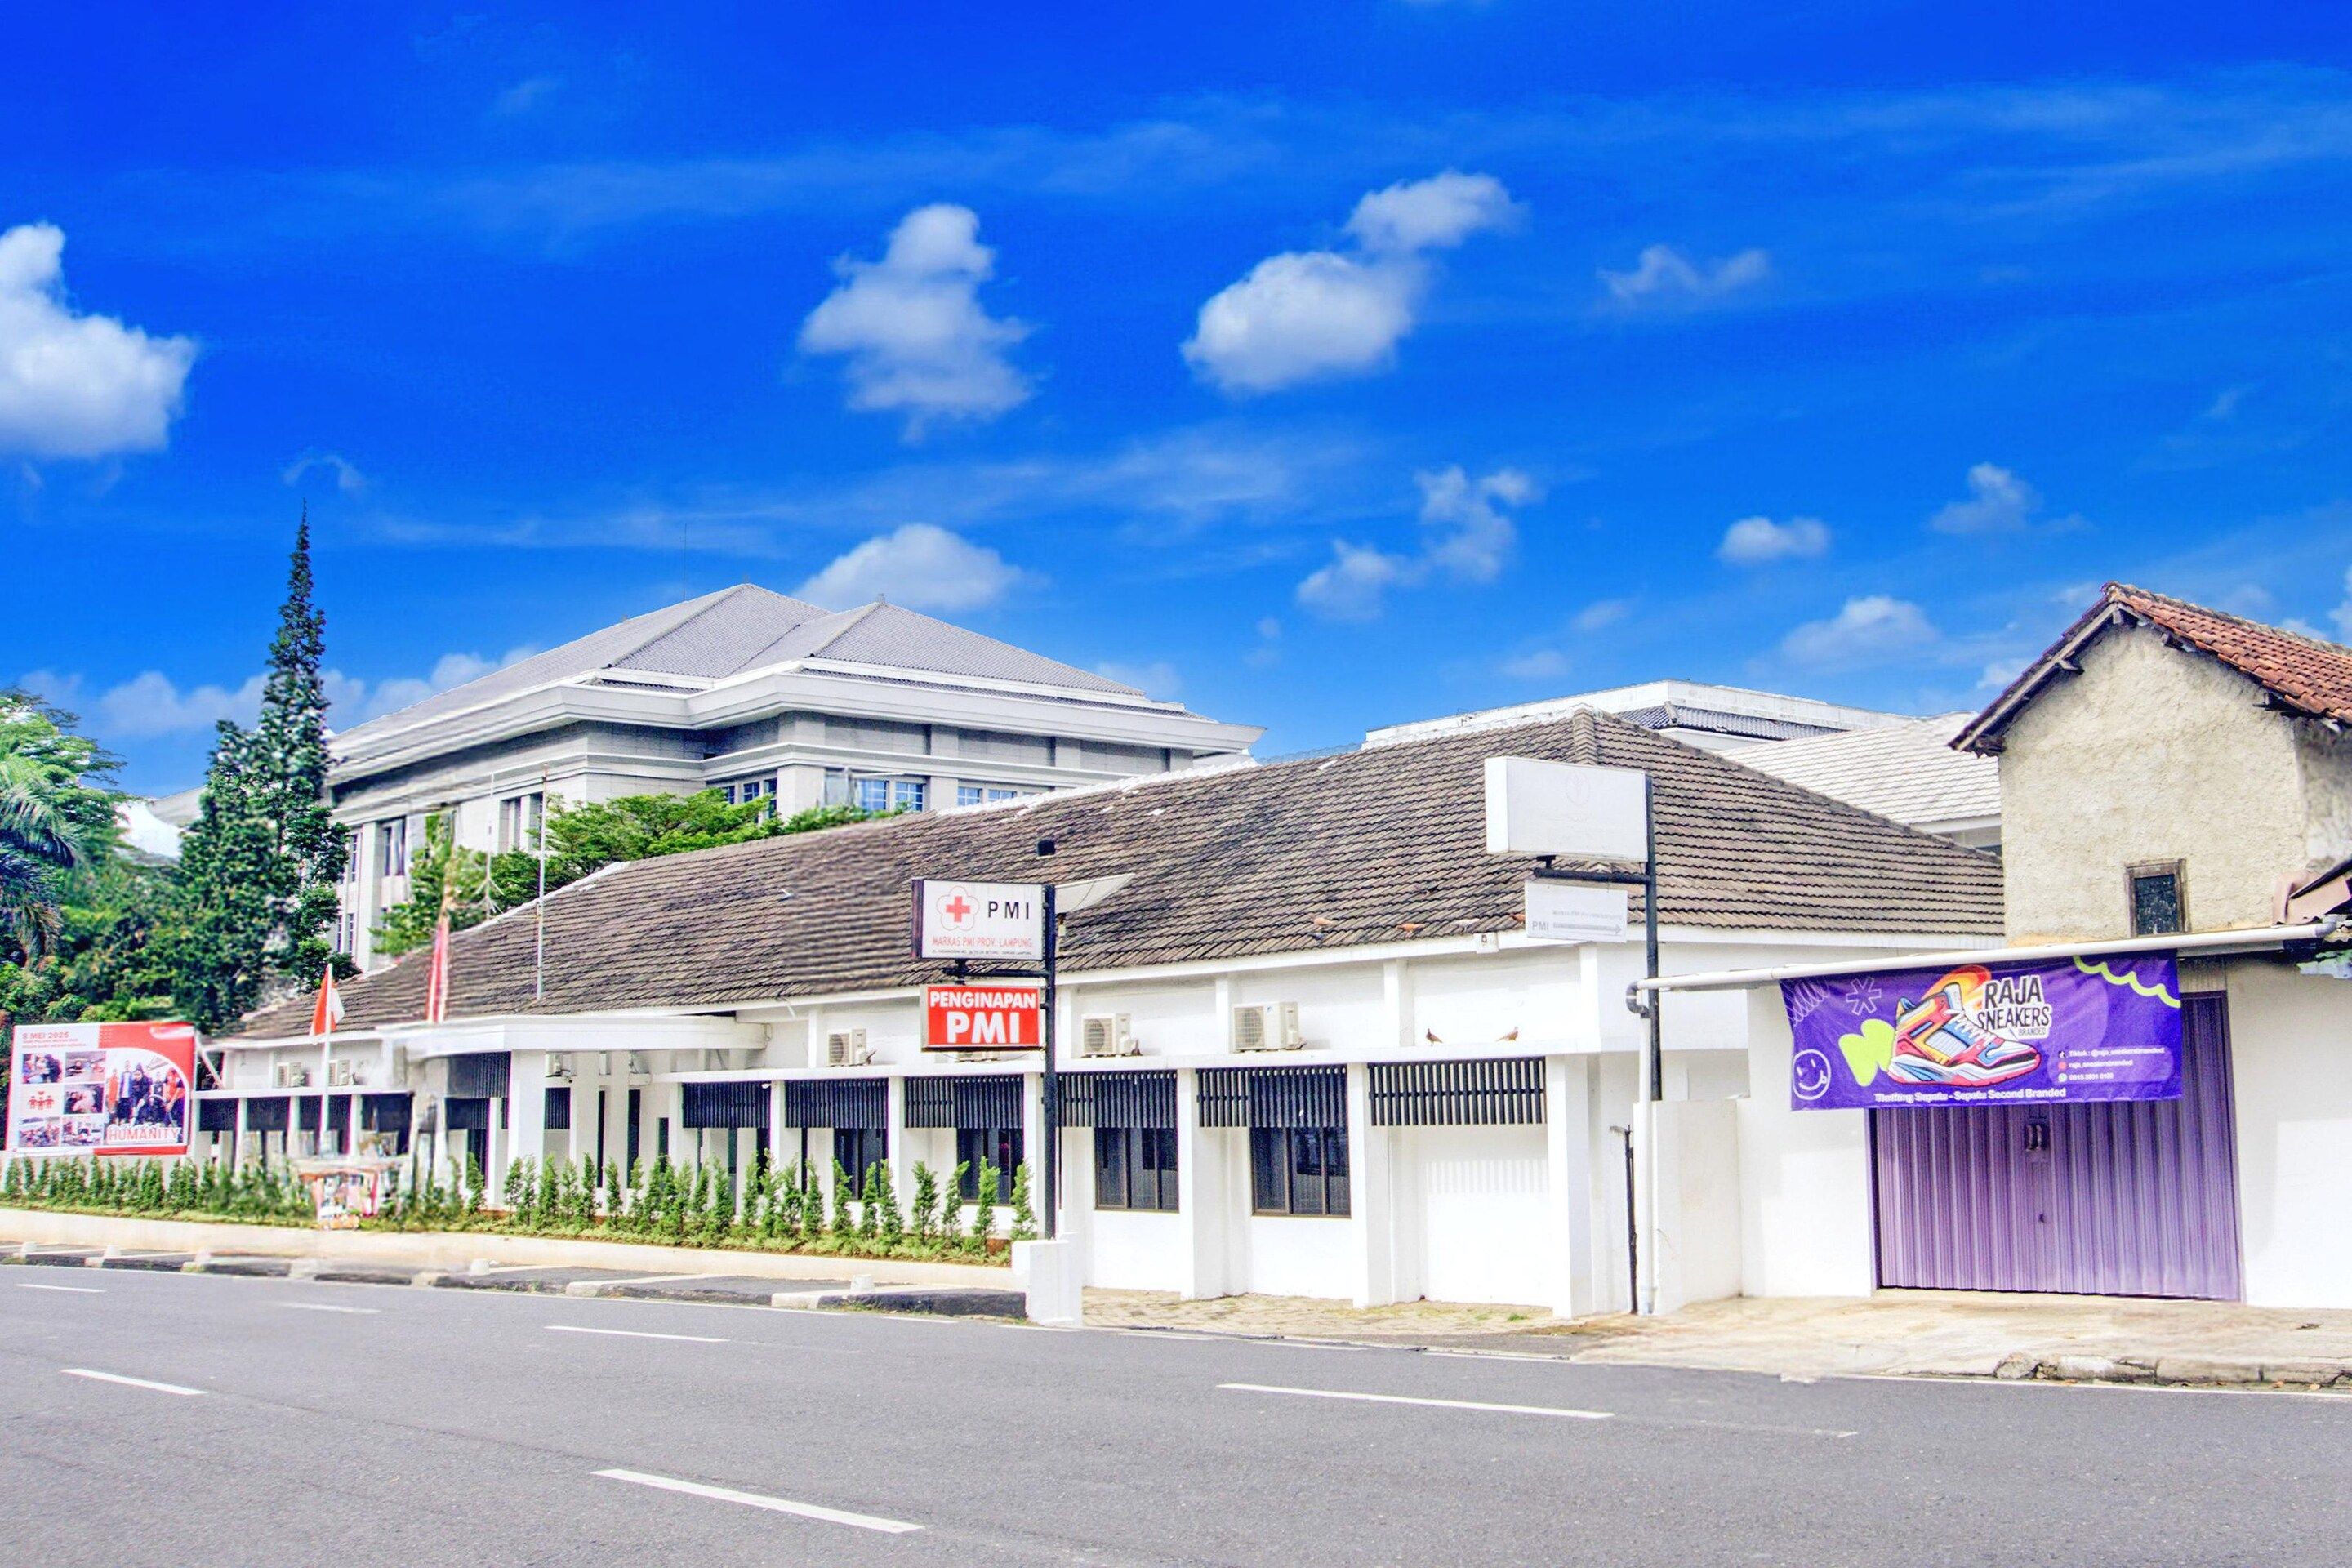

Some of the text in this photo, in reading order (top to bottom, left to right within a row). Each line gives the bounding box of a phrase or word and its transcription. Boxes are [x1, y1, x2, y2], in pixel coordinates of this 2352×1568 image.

[1531, 920, 1549, 931] PMI
[932, 936, 961, 947] MARKAS
[963, 936, 975, 947] PMI
[999, 938, 1032, 947] LAMPUNG
[929, 991, 1036, 1009] PENGINAPAN
[1984, 977, 2042, 1009] RAJA
[1977, 1006, 2049, 1030] SNEAKERS
[946, 1011, 1021, 1044] PMI
[2019, 1027, 2047, 1036] BRANDED
[1953, 1090, 1987, 1102] Sepatu
[1987, 1089, 2024, 1100] Second
[2025, 1087, 2067, 1098] Branded
[109, 1127, 178, 1140] HUMANITY
